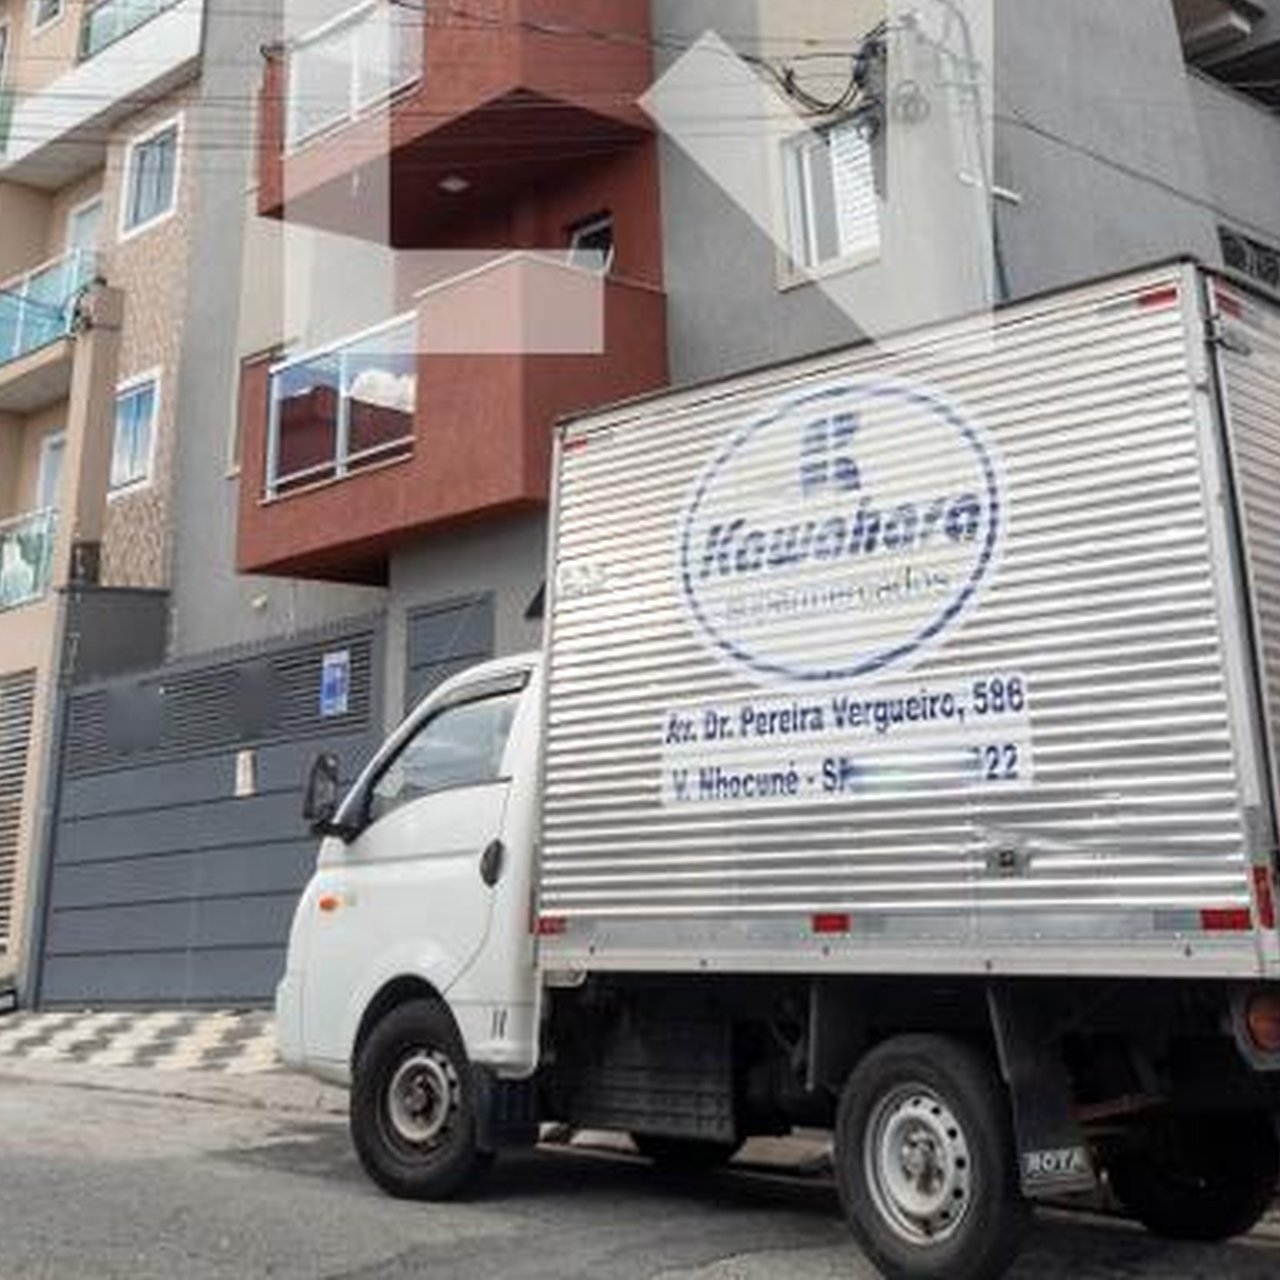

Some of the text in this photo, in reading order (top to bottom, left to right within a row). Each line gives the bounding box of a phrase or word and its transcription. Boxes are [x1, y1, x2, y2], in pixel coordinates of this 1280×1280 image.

[699, 493, 982, 579] Kawahara
[704, 709, 735, 740] Dr.
[741, 704, 824, 738] Pereira
[832, 689, 965, 734] Vergueiro,
[973, 676, 1025, 714] 586
